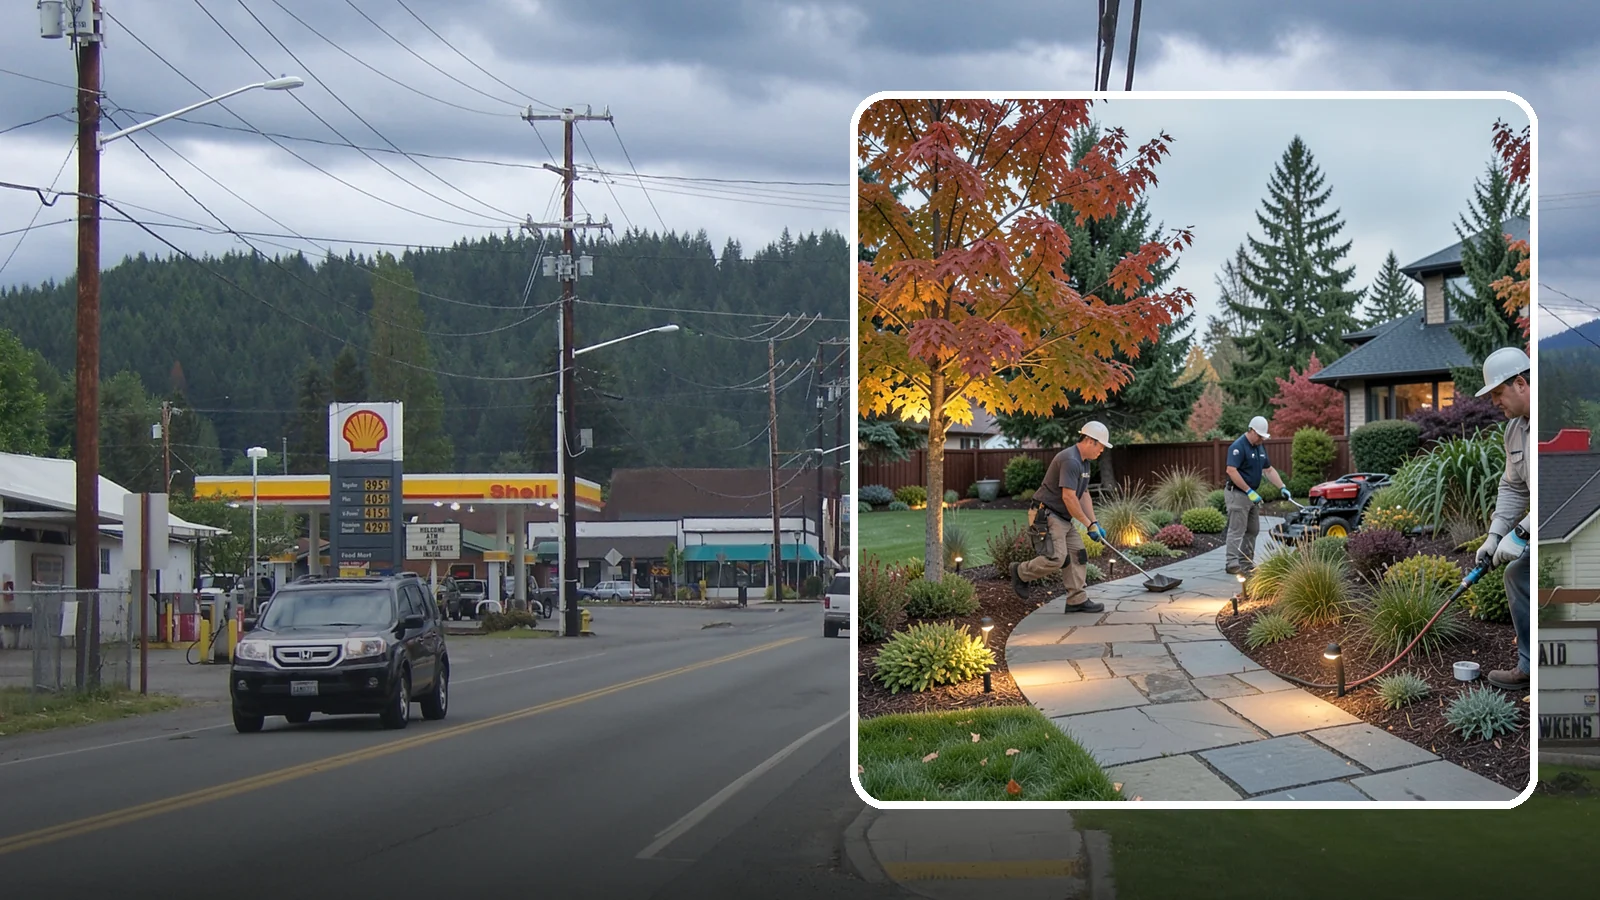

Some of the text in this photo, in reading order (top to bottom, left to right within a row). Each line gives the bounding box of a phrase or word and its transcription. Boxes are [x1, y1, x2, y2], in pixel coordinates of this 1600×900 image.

[490, 484, 547, 499] Shell
[1538, 643, 1567, 665] AID
[1538, 716, 1592, 739] WKENS
